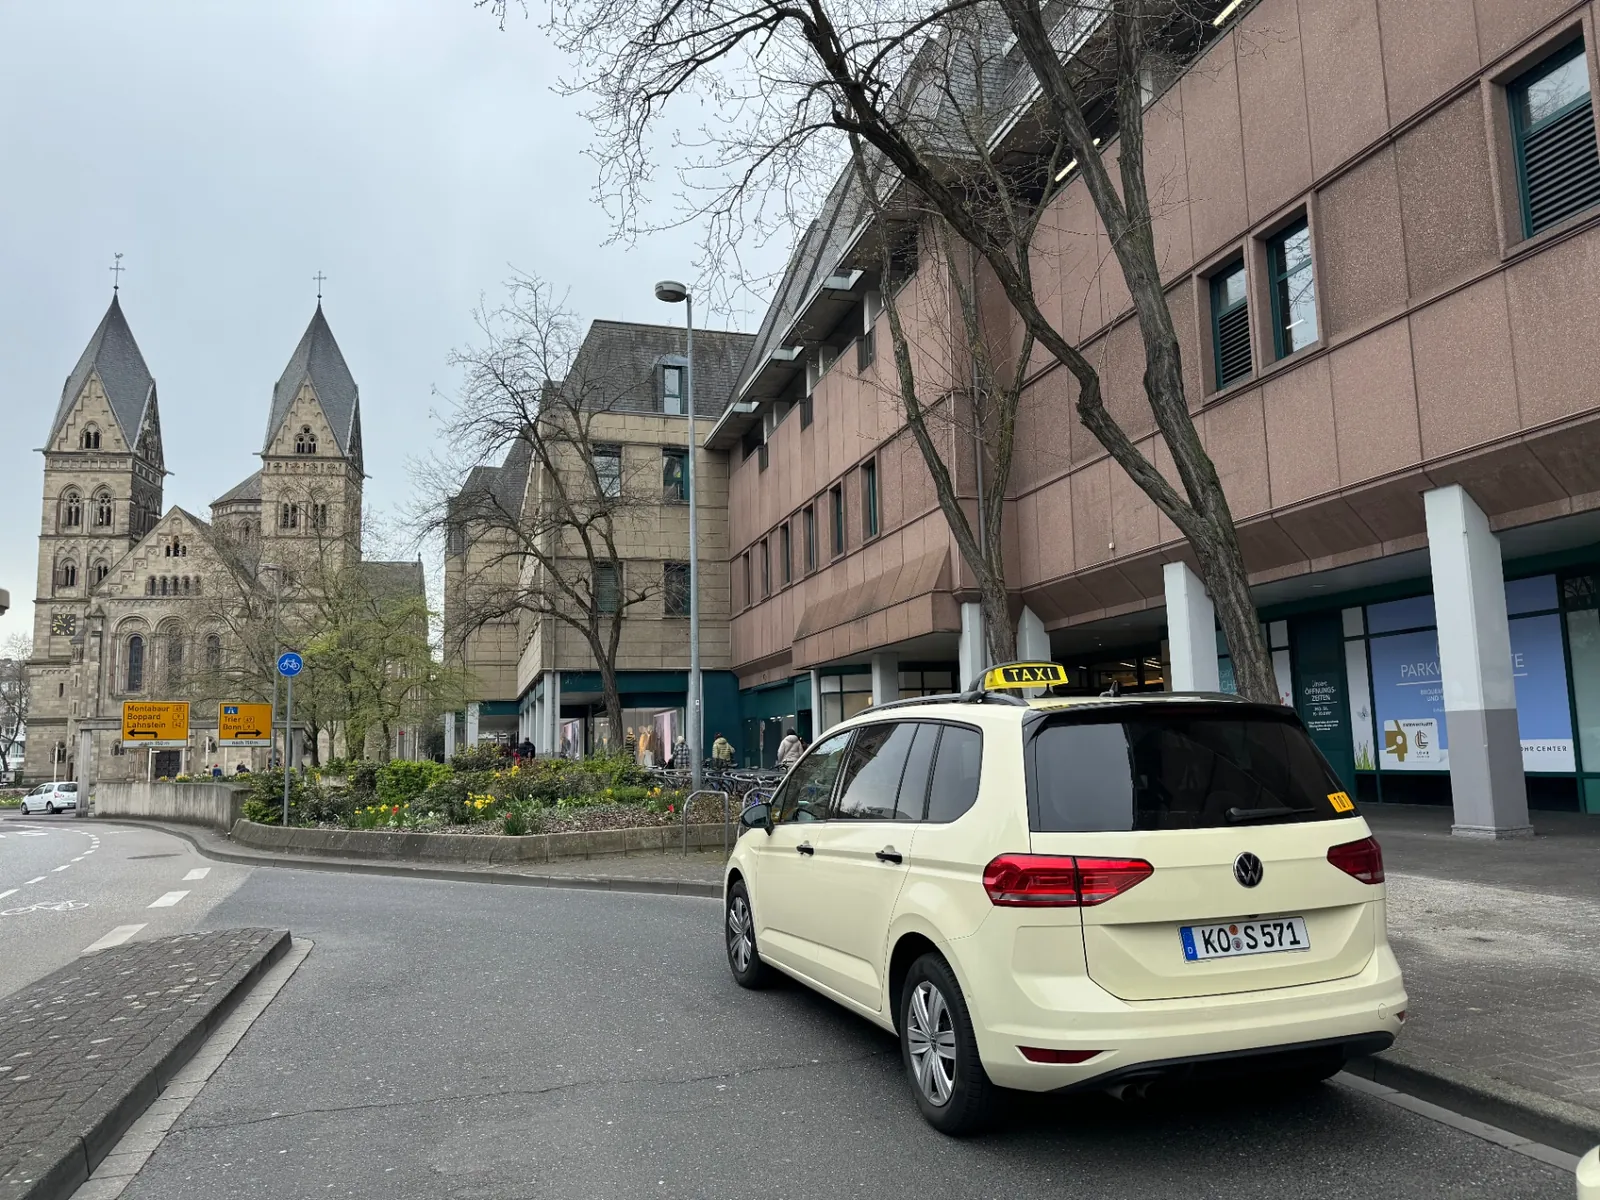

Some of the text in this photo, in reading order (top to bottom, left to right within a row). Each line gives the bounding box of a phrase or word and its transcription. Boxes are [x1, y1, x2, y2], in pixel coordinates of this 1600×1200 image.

[1009, 667, 1054, 682] TAXI
[127, 713, 161, 721] Boppard
[1201, 927, 1231, 954] KO
